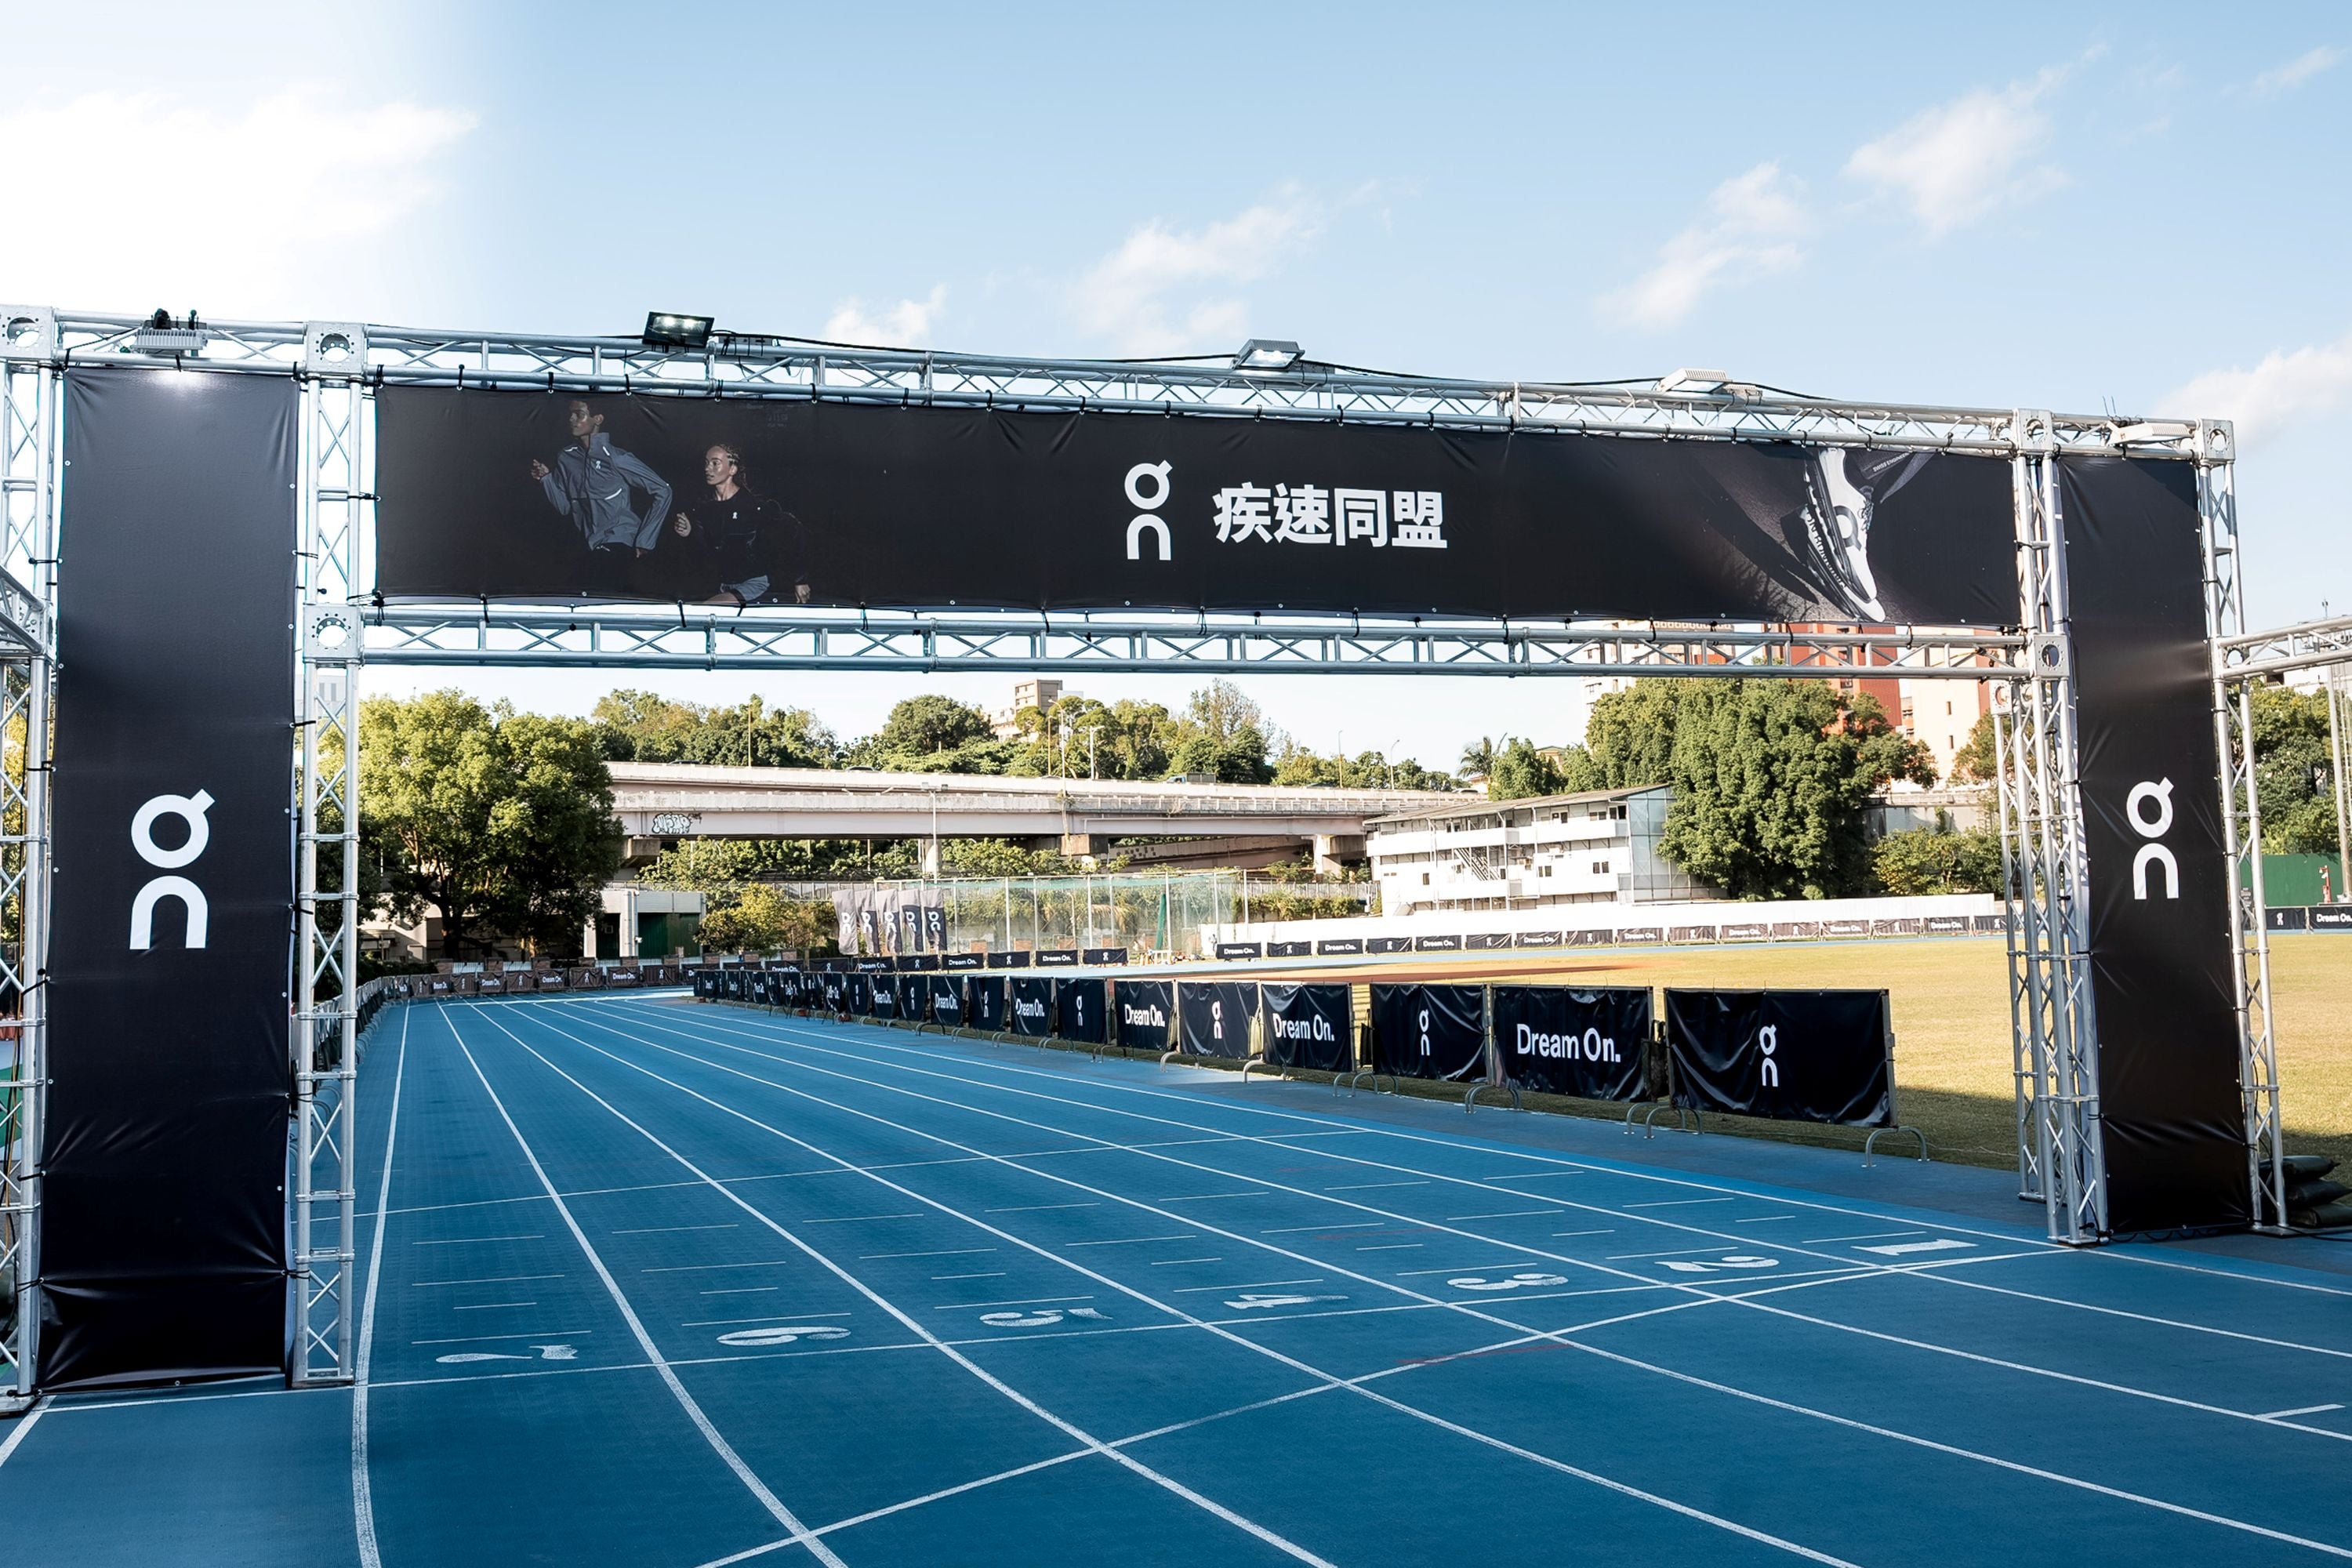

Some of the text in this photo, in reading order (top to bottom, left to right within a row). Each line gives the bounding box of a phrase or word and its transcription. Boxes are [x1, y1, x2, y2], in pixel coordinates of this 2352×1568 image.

[1213, 482, 1448, 549] 疾速同盟
[1016, 998, 1033, 1017] Dream
[1124, 1004, 1149, 1025] Dream
[1273, 1013, 1334, 1041] Dream On.
[1517, 1024, 1621, 1063] Dream On.
